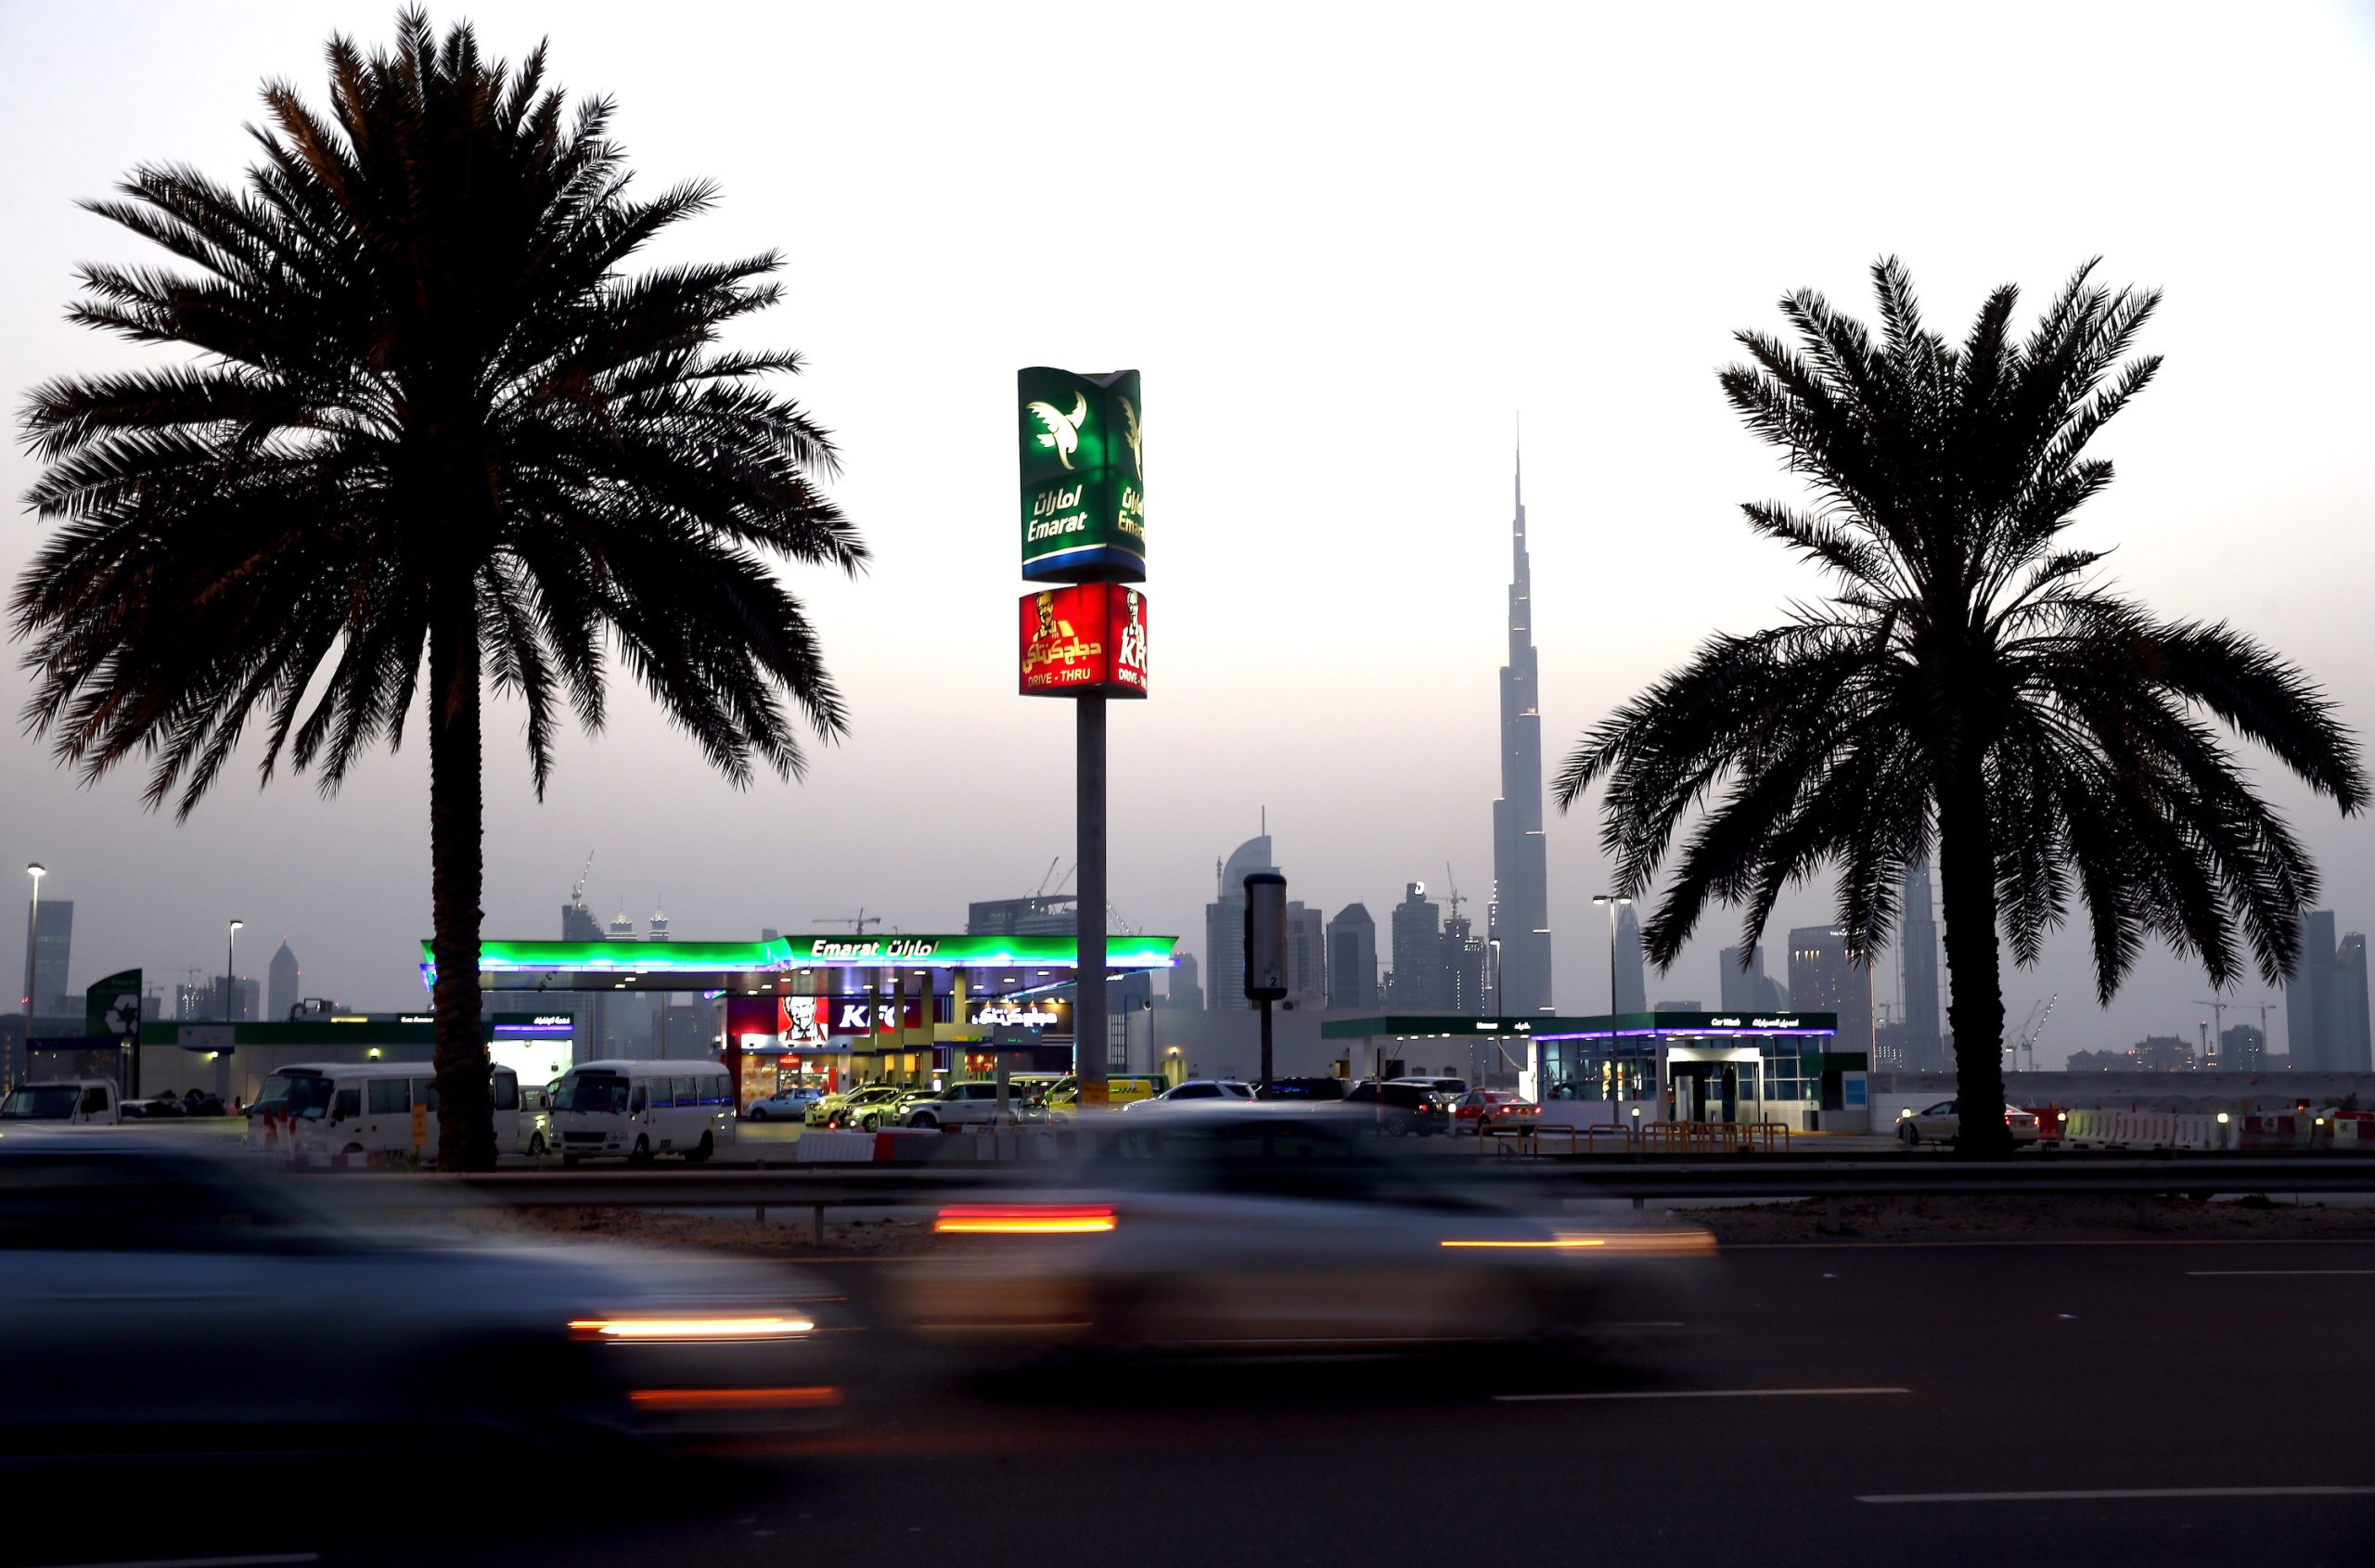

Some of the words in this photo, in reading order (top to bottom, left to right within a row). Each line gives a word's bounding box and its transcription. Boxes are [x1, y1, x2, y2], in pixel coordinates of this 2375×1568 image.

[1033, 484, 1083, 517] امارات
[1028, 511, 1088, 542] Emarat
[1064, 636, 1102, 665] دجاج
[1028, 673, 1053, 687] DRIVE
[1060, 667, 1091, 682] THRU
[1118, 667, 1138, 685] DRIVE
[811, 939, 880, 958] Emarat
[886, 939, 940, 959] امارات
